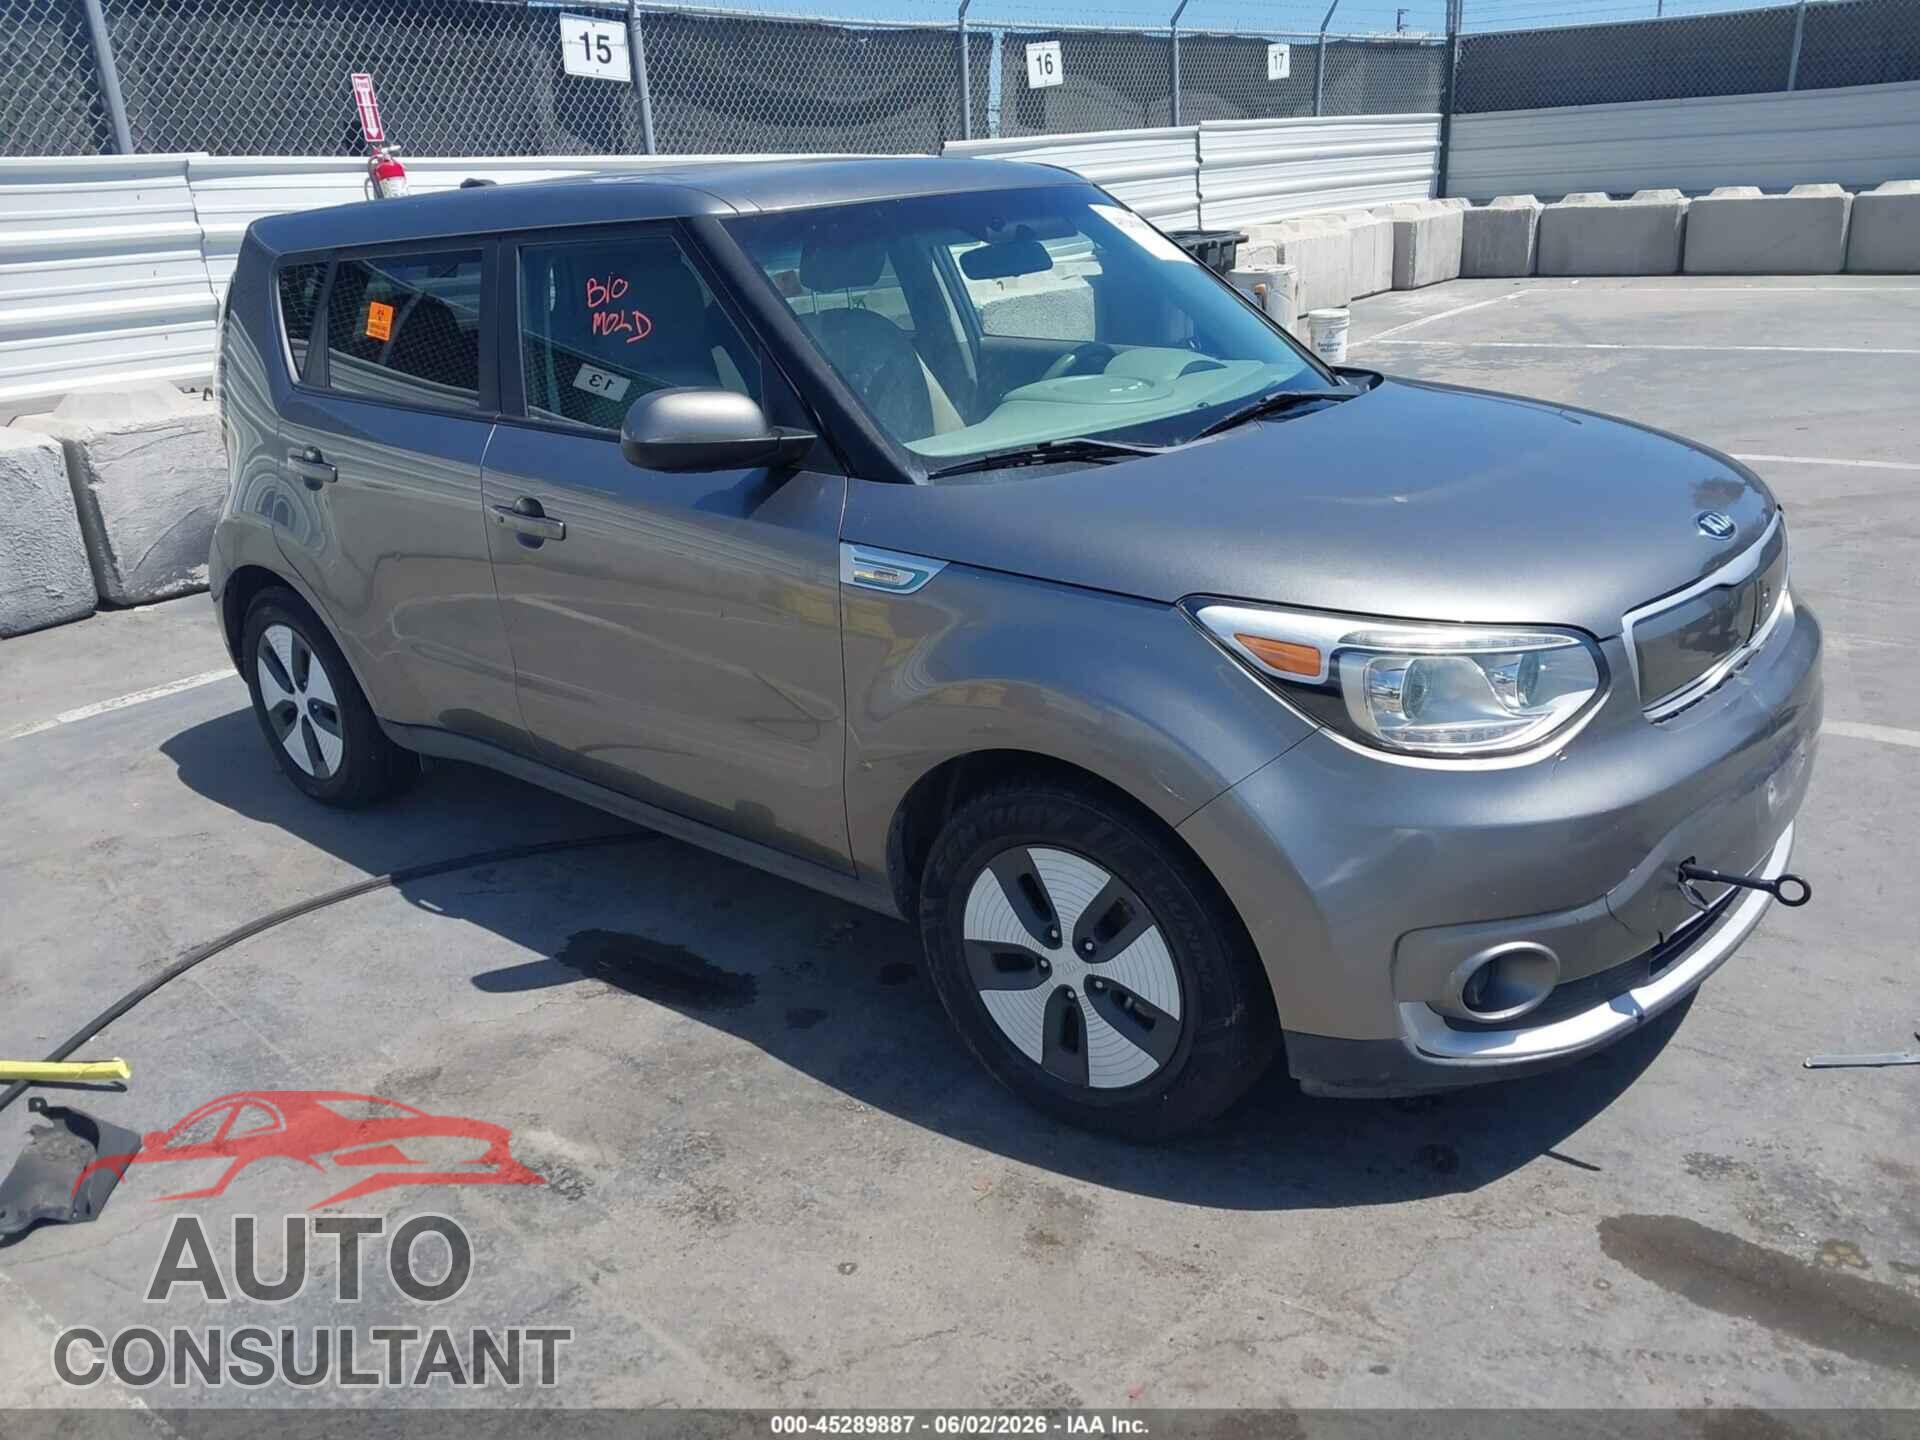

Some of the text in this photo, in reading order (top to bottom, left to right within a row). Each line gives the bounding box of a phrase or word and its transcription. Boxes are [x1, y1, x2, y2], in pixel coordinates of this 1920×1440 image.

[578, 30, 613, 65] 15
[1272, 52, 1286, 71] 17
[1035, 52, 1054, 76] 16
[592, 309, 652, 343] MOLD
